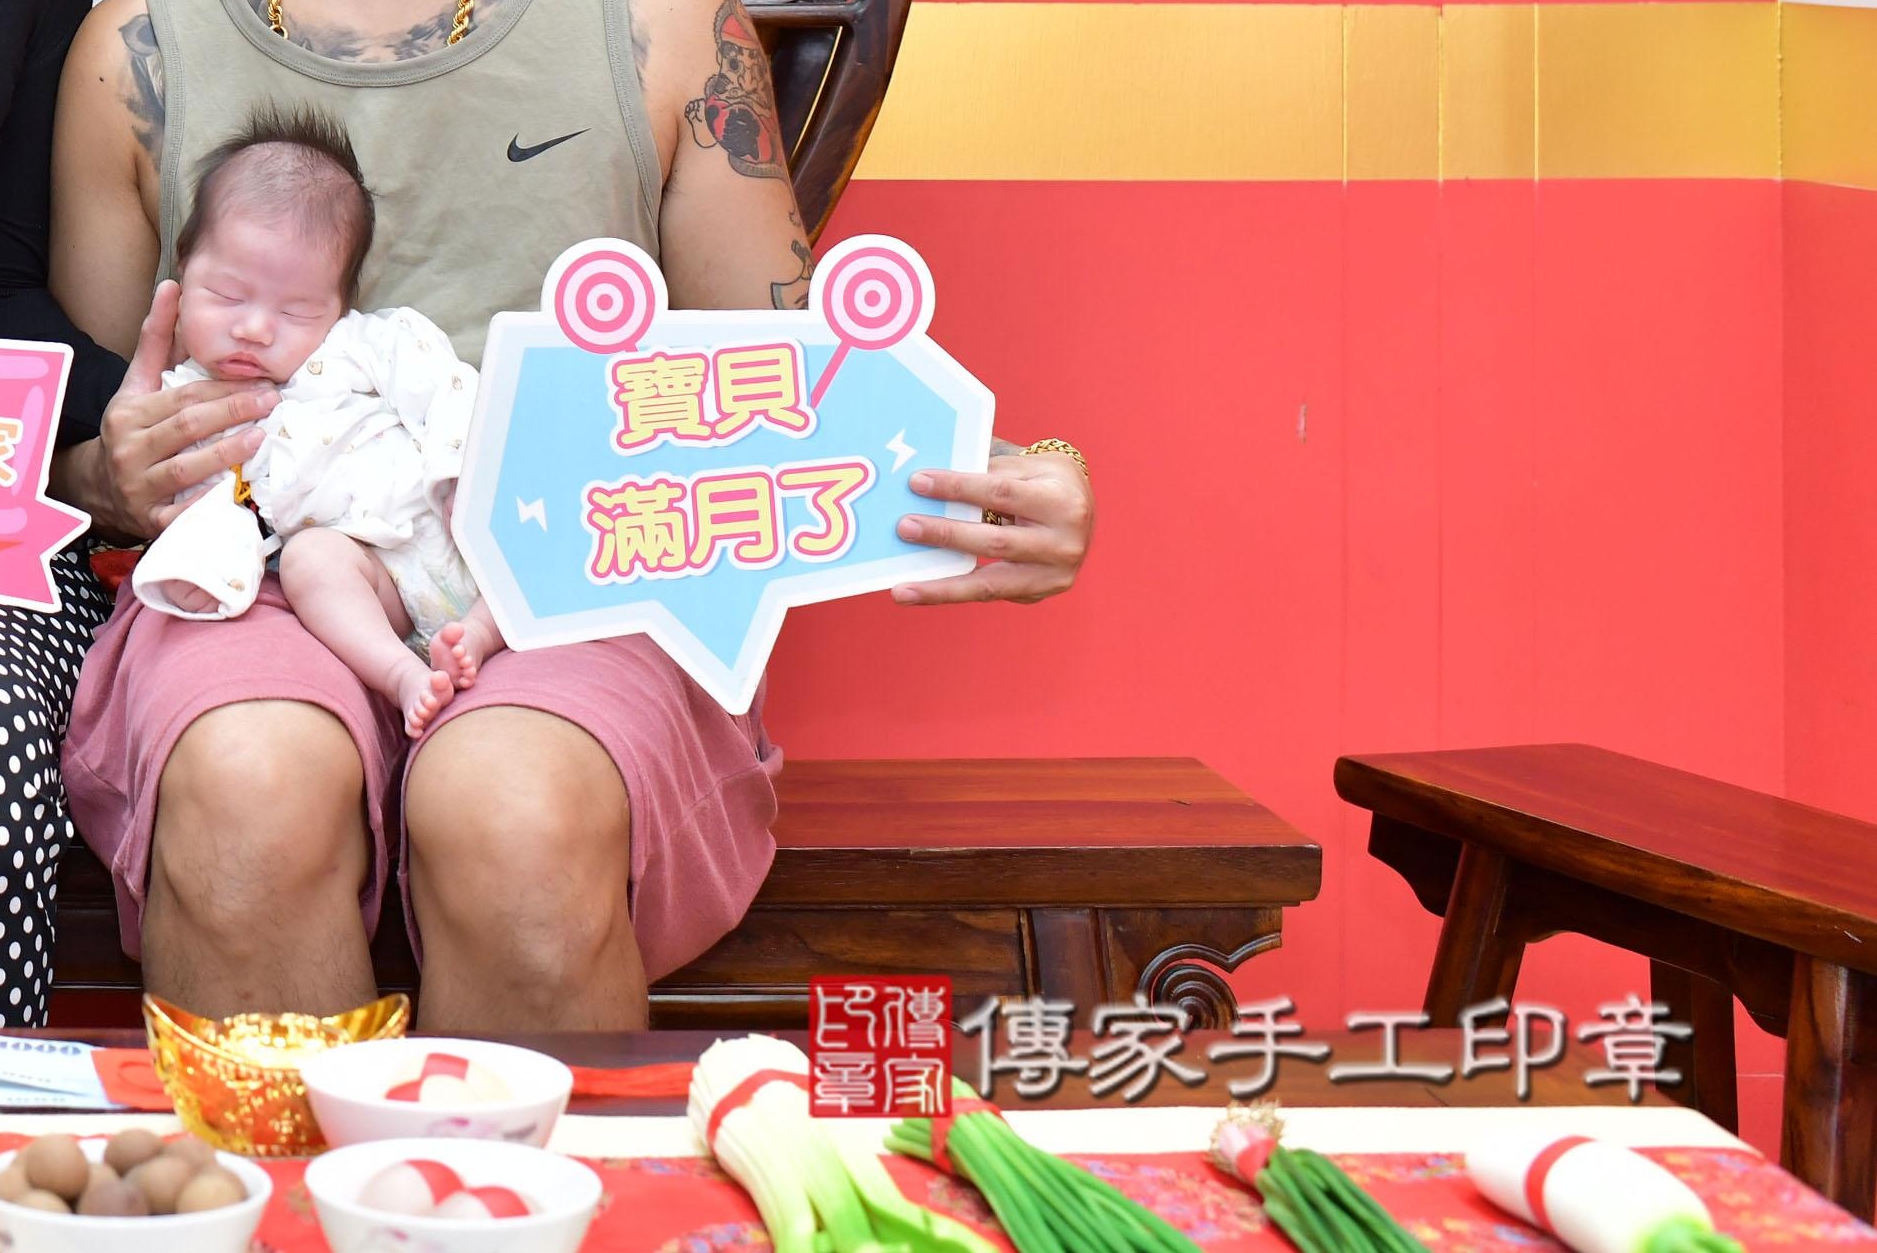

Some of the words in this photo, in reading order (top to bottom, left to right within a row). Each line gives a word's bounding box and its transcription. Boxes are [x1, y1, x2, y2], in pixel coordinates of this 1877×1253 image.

[614, 340, 809, 449] 寶貝
[588, 461, 873, 579] 滿月了
